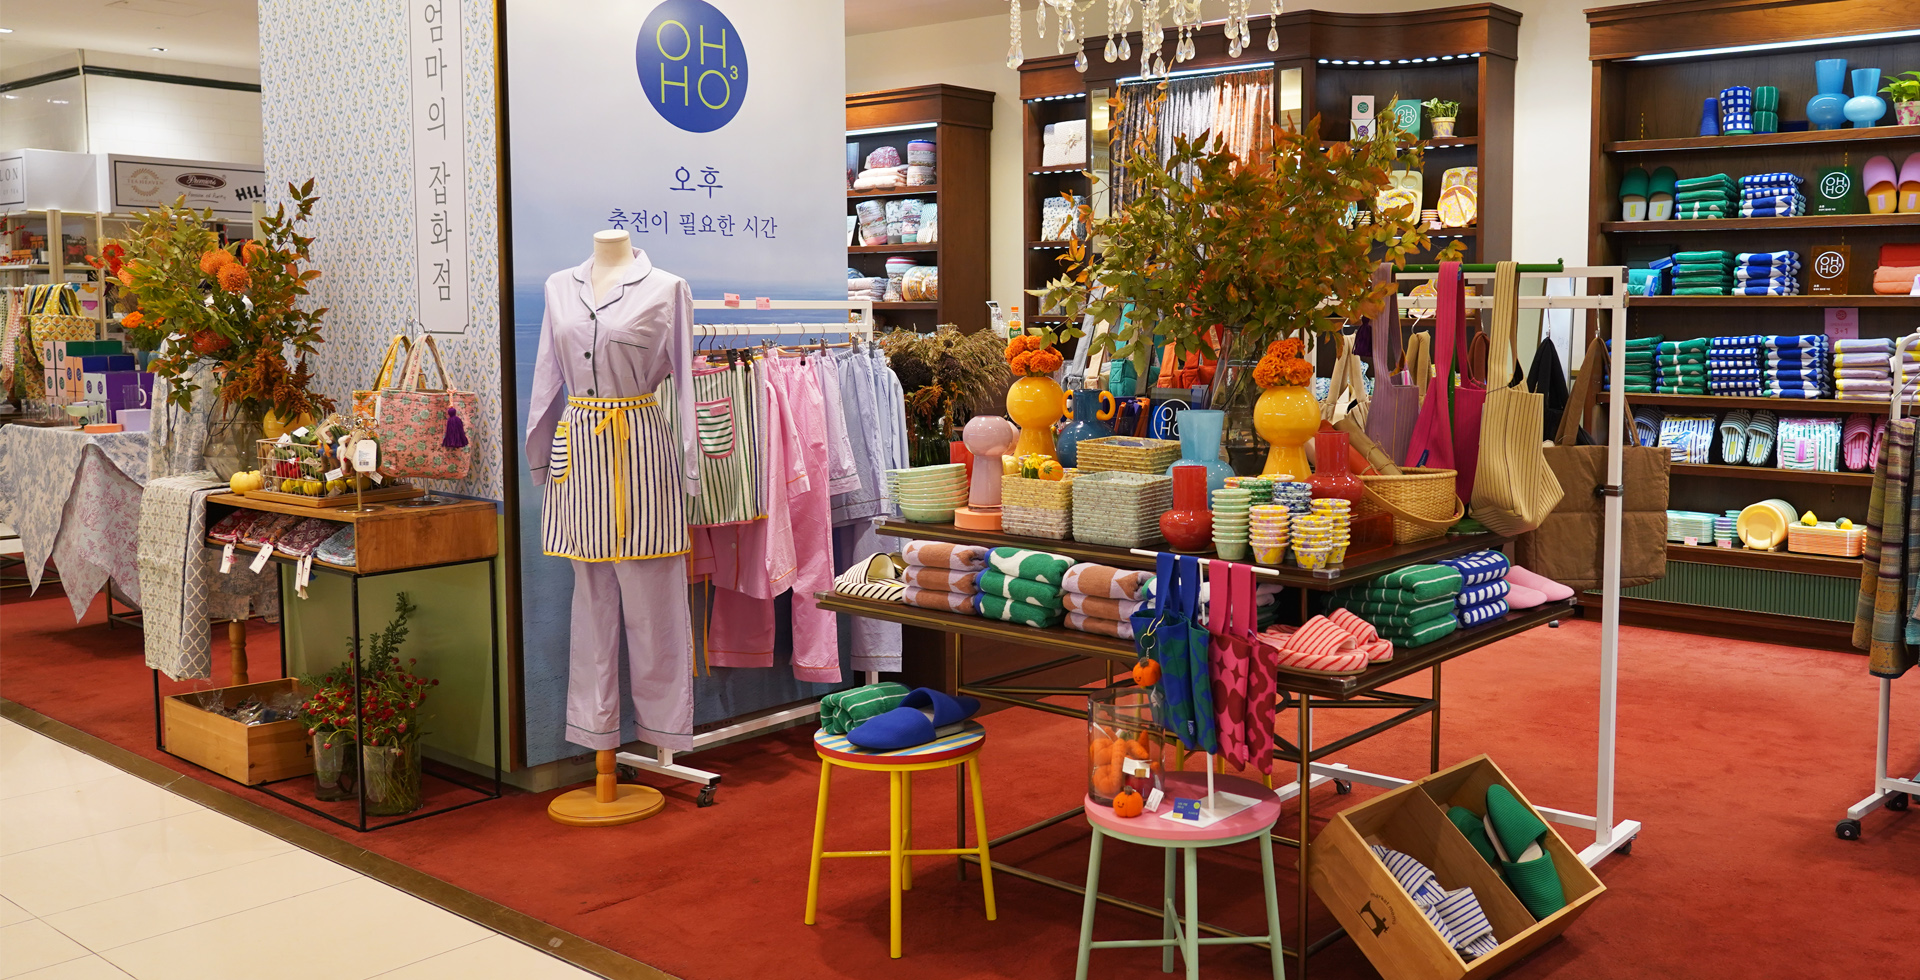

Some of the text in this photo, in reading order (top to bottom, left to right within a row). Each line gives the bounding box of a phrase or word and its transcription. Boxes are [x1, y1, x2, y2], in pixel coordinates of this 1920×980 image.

[656, 19, 727, 68] OH
[424, 0, 452, 302] 엄마의 잡화점
[235, 185, 266, 201] HIL
[669, 166, 723, 199] 오후
[1825, 176, 1845, 186] OH
[608, 208, 778, 239] 충전이 필요한 시간
[1820, 256, 1840, 265] OH
